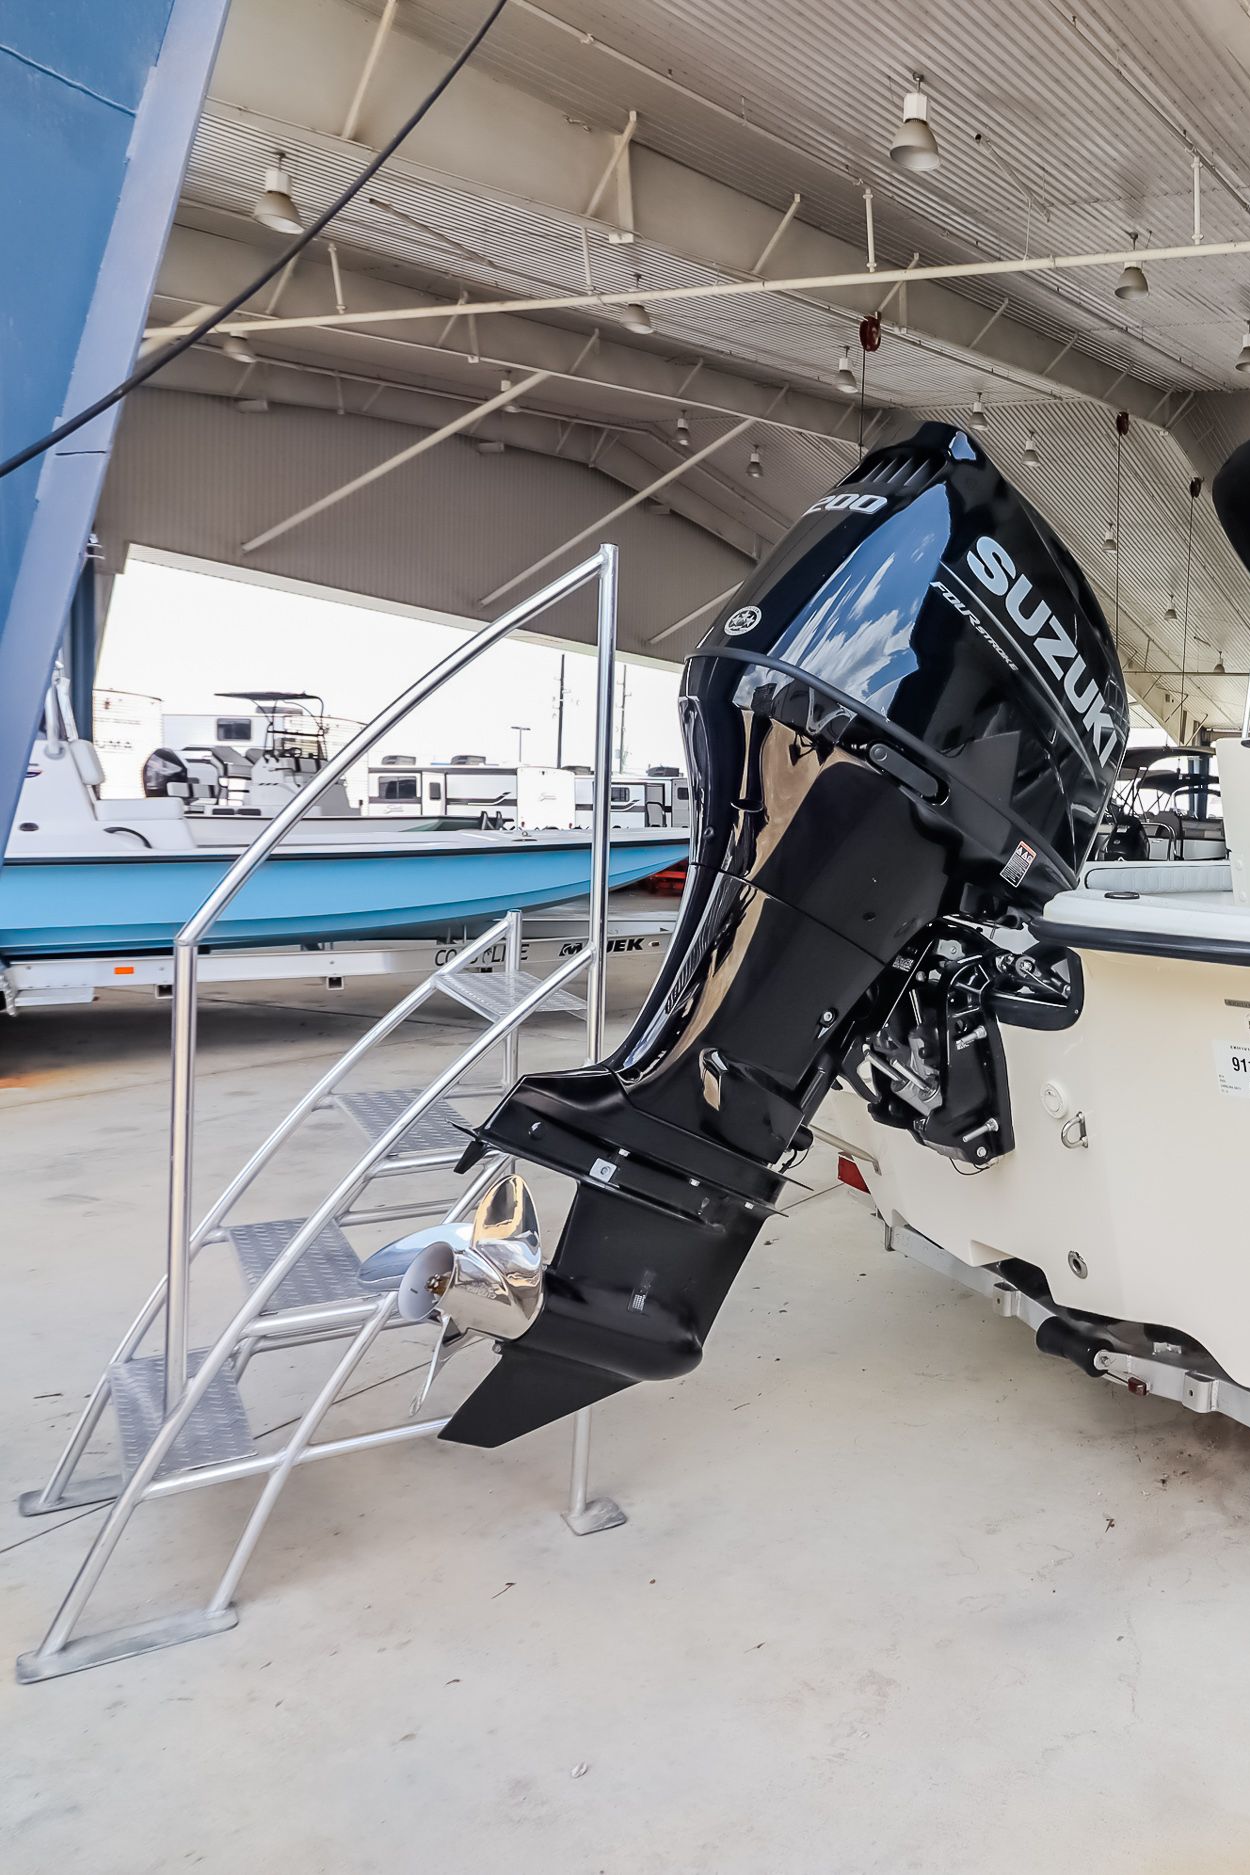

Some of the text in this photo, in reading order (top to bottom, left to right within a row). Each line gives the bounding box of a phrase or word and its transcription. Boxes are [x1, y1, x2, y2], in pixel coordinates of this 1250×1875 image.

[801, 493, 888, 516] 200
[966, 535, 1118, 769] SUZUKI
[435, 943, 530, 966] COLIE
[559, 937, 645, 957] MJEK
